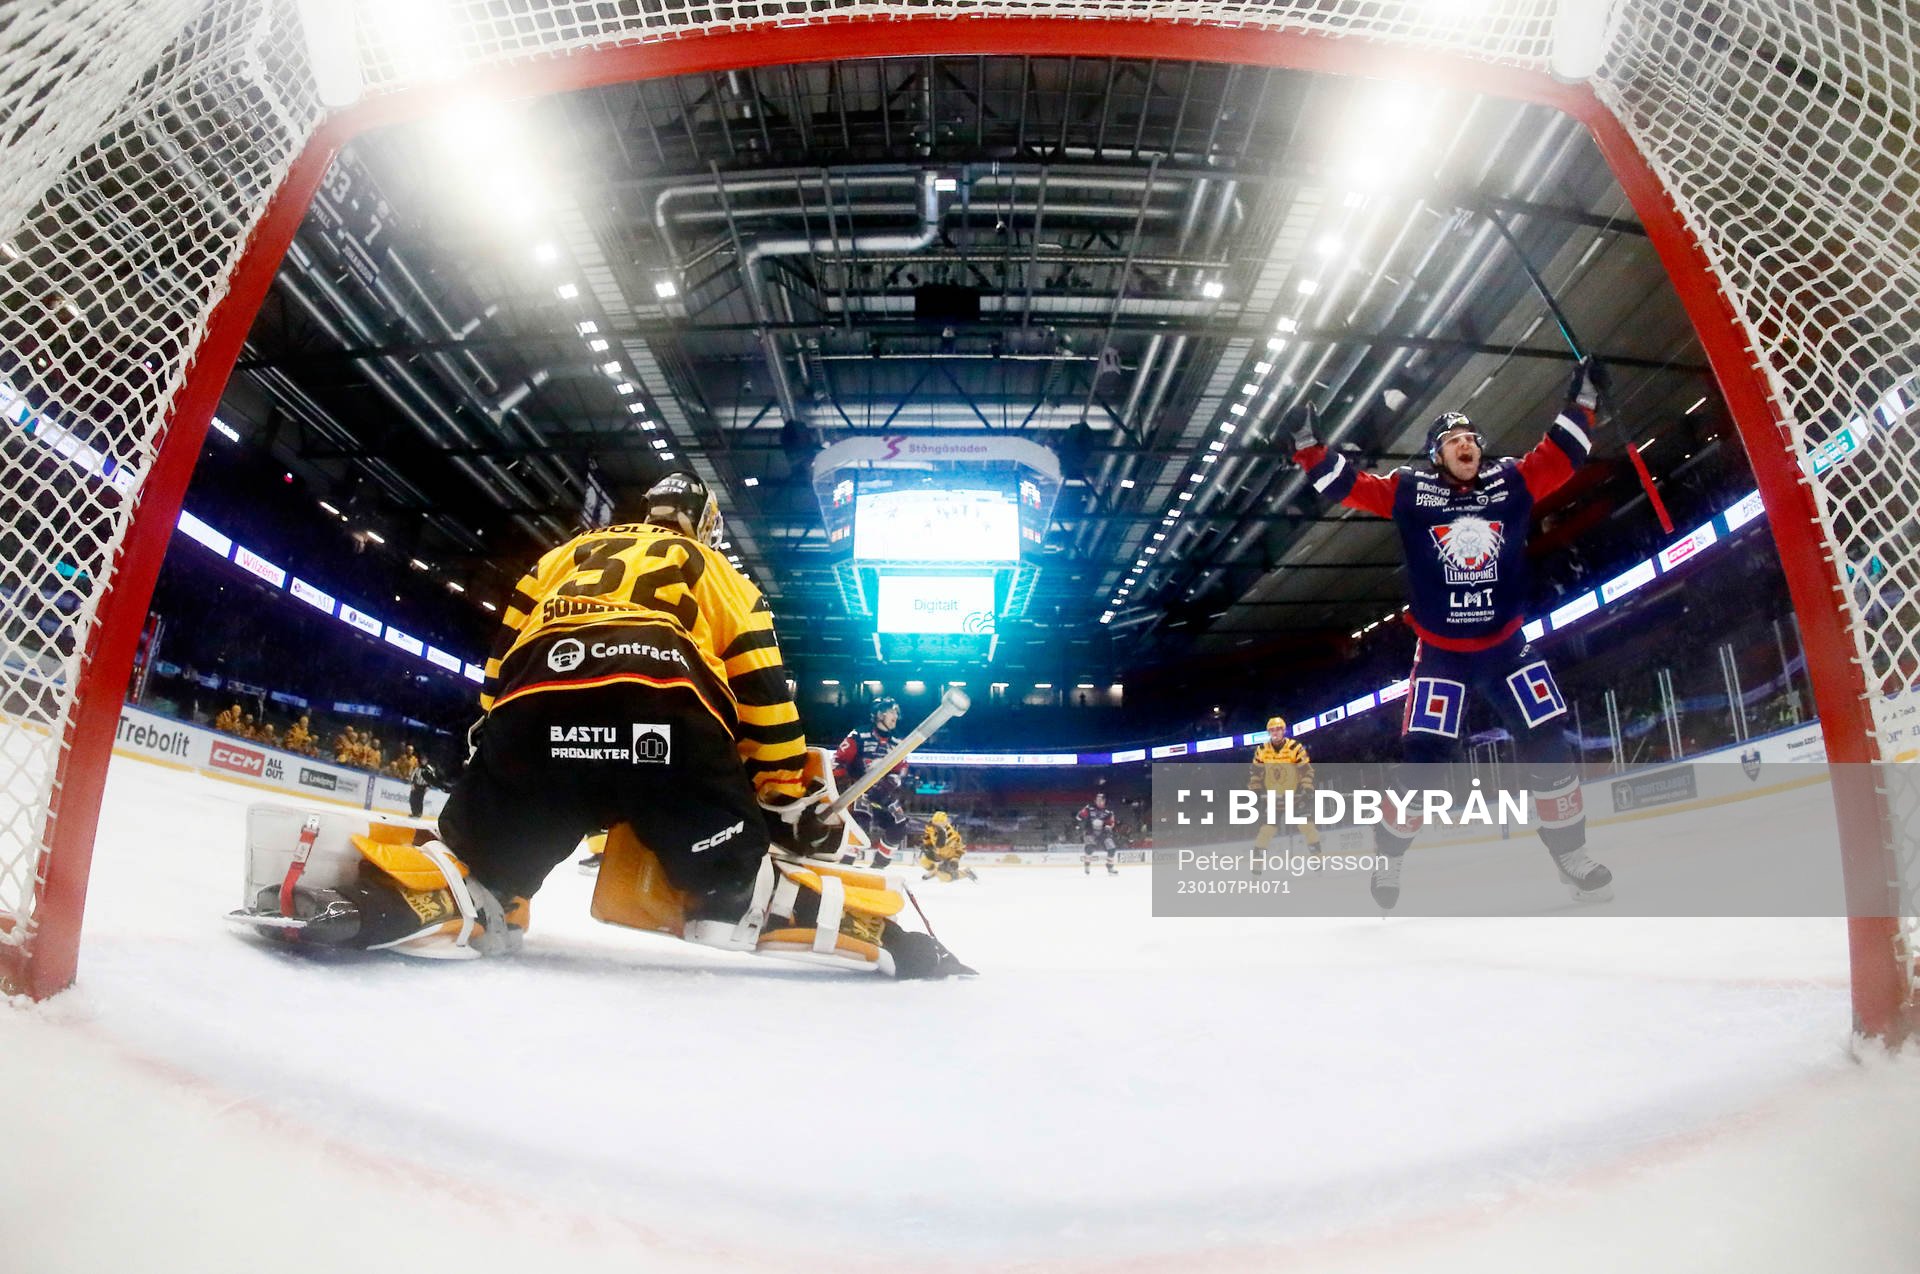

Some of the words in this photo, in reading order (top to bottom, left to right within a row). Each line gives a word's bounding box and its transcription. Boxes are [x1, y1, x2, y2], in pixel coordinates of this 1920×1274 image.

[908, 443, 988, 455] Stångåstaden
[243, 551, 280, 582] Wilzens
[556, 537, 705, 632] 32
[913, 598, 958, 613] Digitalt
[1450, 588, 1493, 608] LMT
[116, 716, 190, 757] Trebolit
[550, 726, 616, 742] BASTU
[212, 748, 263, 771] CCM
[551, 747, 629, 760] PRODUKTER
[267, 758, 283, 770] ALL
[1557, 793, 1577, 812] BC
[691, 821, 744, 853] CCM
